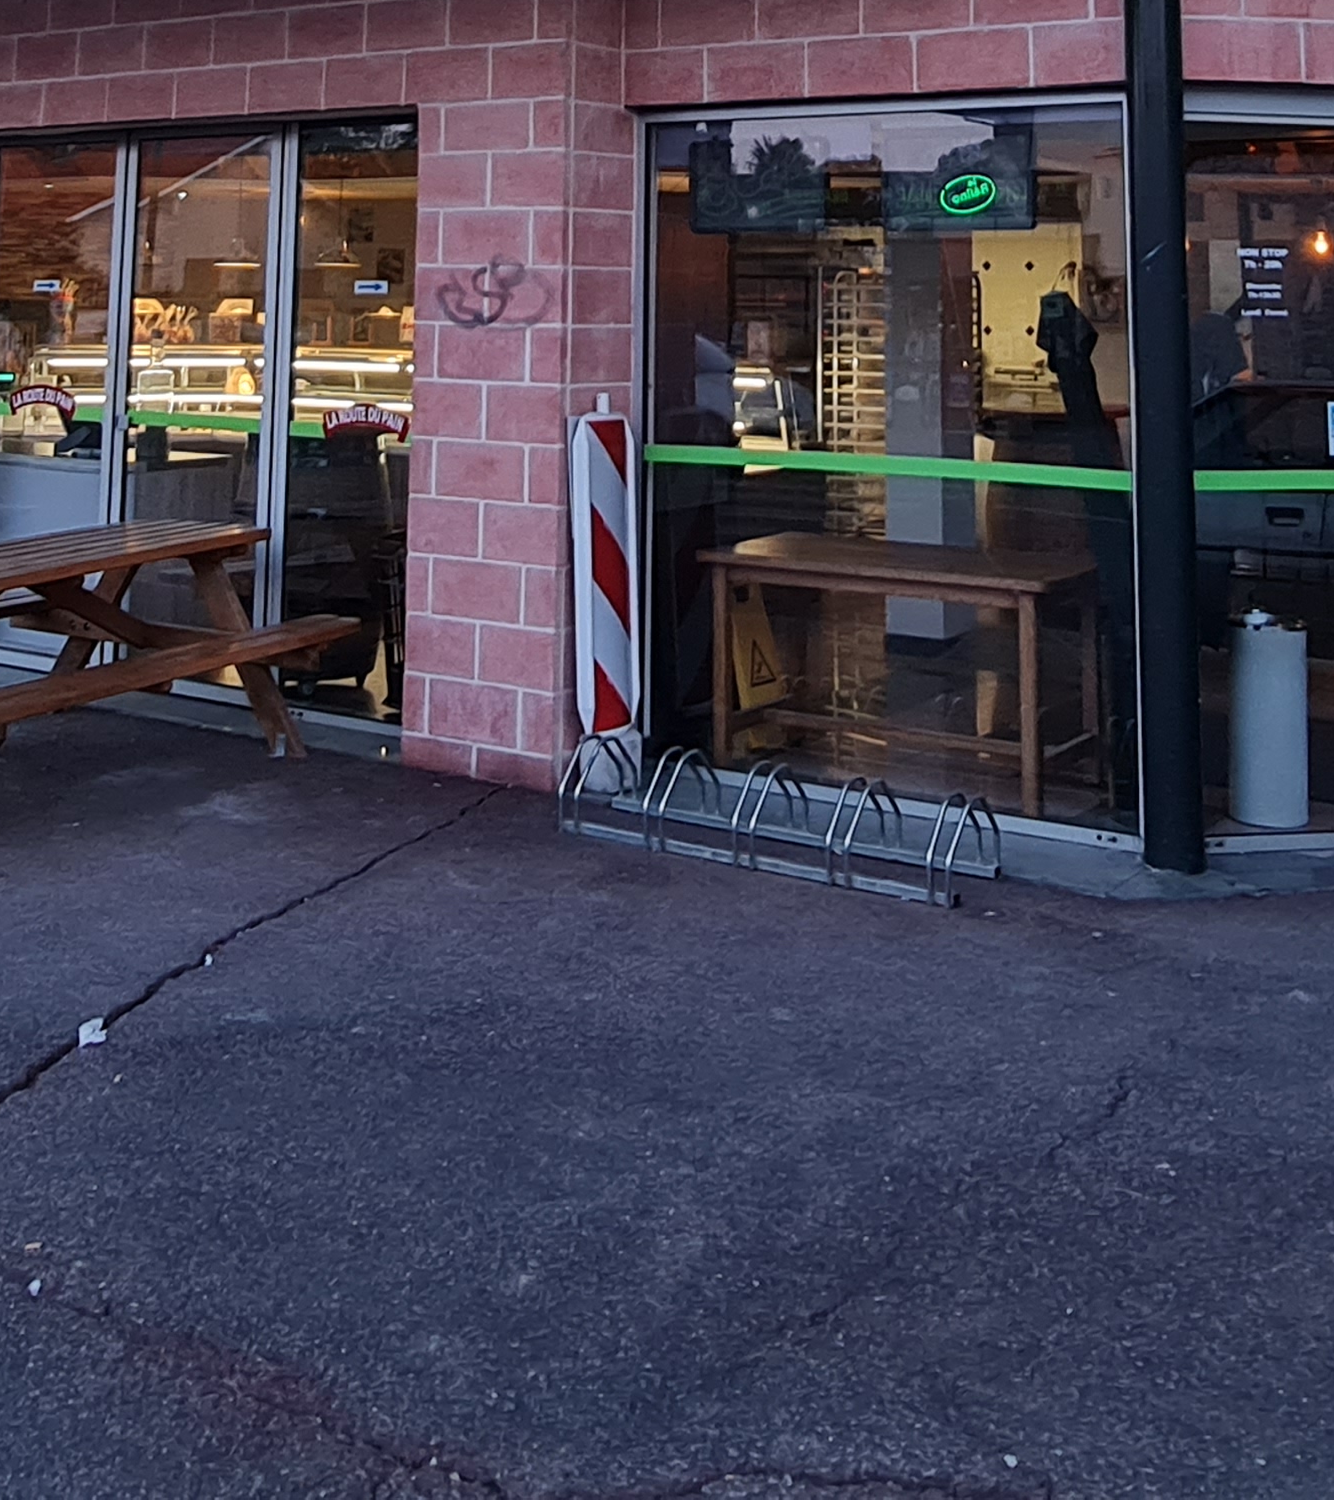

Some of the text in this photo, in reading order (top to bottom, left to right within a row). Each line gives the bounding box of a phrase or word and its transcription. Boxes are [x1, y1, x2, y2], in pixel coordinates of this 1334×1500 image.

[1261, 248, 1289, 258] STOP
[12, 392, 22, 408] LA
[22, 387, 45, 403] ROUTE
[45, 388, 56, 403] DU
[326, 406, 405, 432] LA ROUTE DU PAIN
